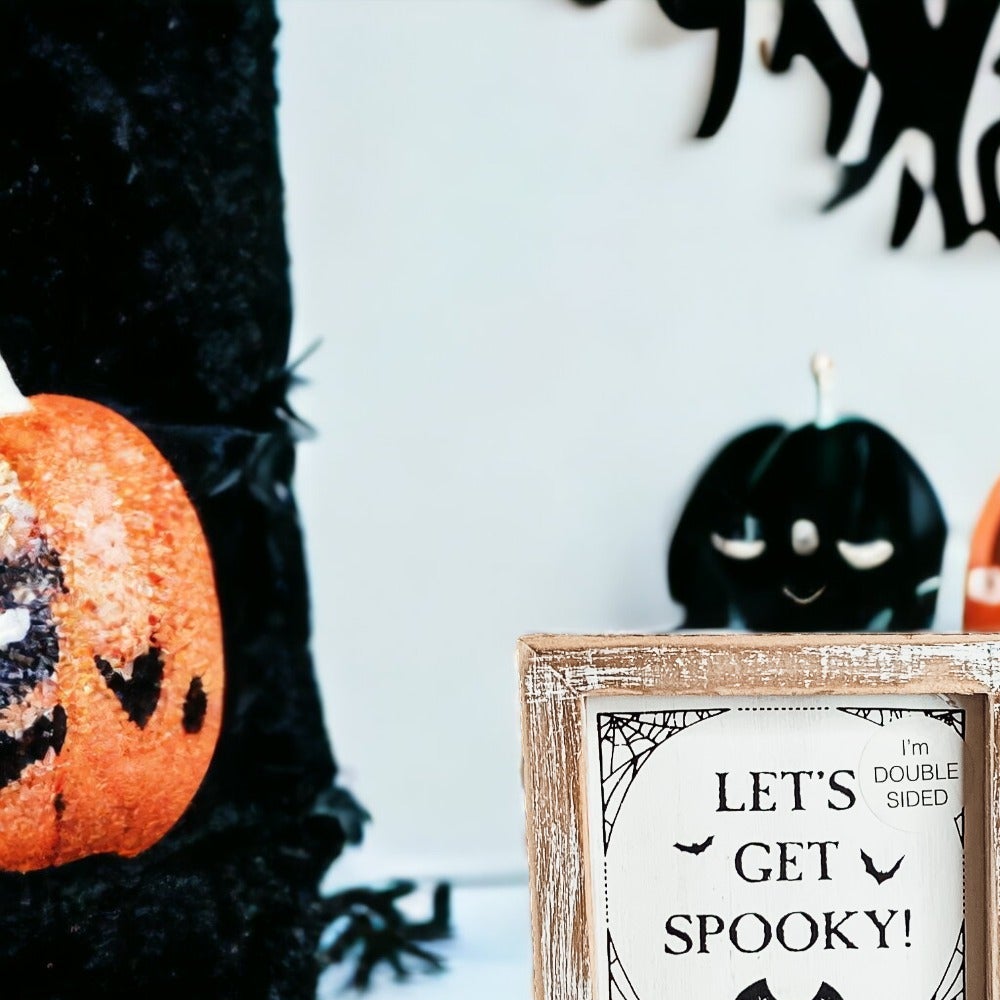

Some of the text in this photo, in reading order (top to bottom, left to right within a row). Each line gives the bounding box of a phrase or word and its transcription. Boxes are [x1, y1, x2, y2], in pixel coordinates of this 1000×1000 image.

[901, 738, 930, 757] I'm
[873, 761, 959, 784] DOUBLE
[715, 770, 856, 812] LET'S
[886, 788, 949, 809] SIDED
[733, 840, 840, 883] GET
[663, 909, 912, 955] SPOOKY!
